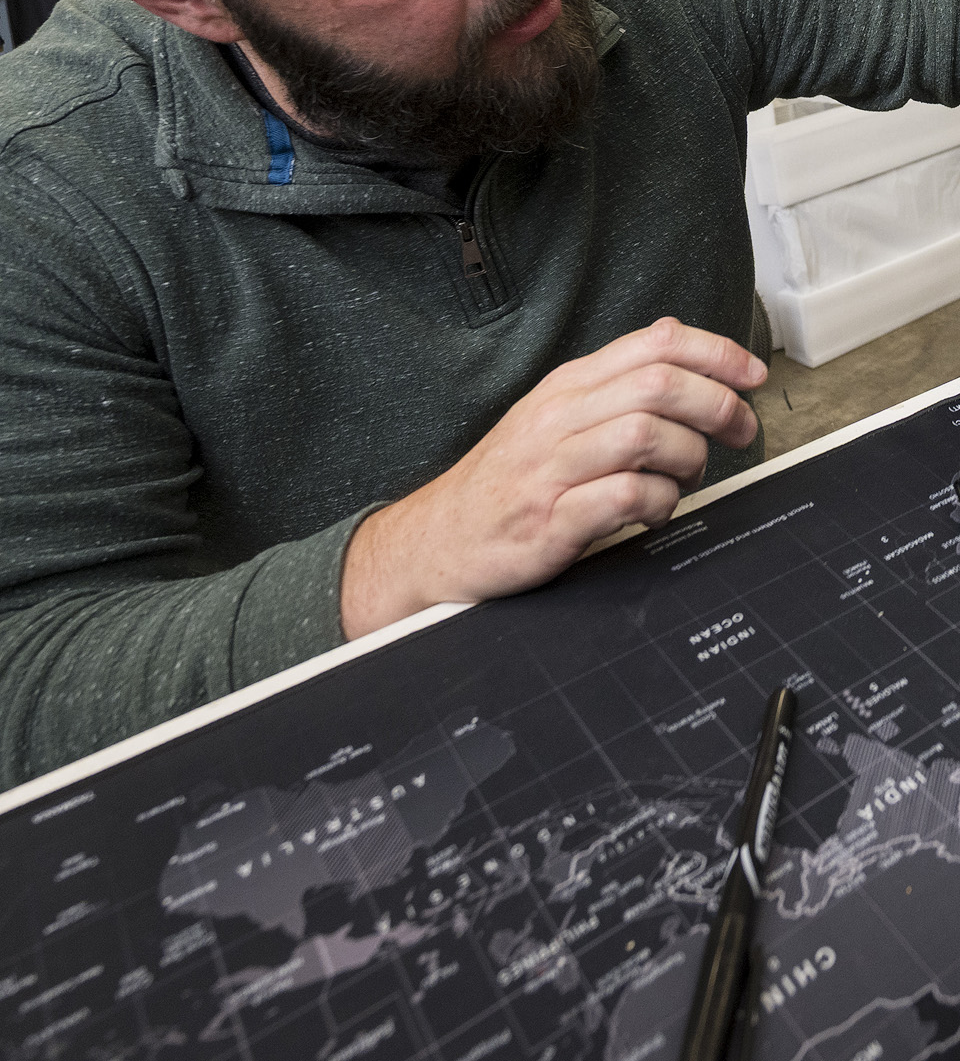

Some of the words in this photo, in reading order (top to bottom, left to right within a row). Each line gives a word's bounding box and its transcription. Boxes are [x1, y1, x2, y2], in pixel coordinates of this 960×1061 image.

[883, 529, 934, 562] MADAGASCAR
[687, 610, 744, 646] OCEAN
[695, 624, 756, 662] INDIAN
[862, 675, 908, 709] MALDIVES
[804, 710, 838, 735] LANKA
[853, 768, 928, 824] INDIA
[234, 772, 428, 878] AUSTRALIA
[760, 946, 836, 1013] CHIN
